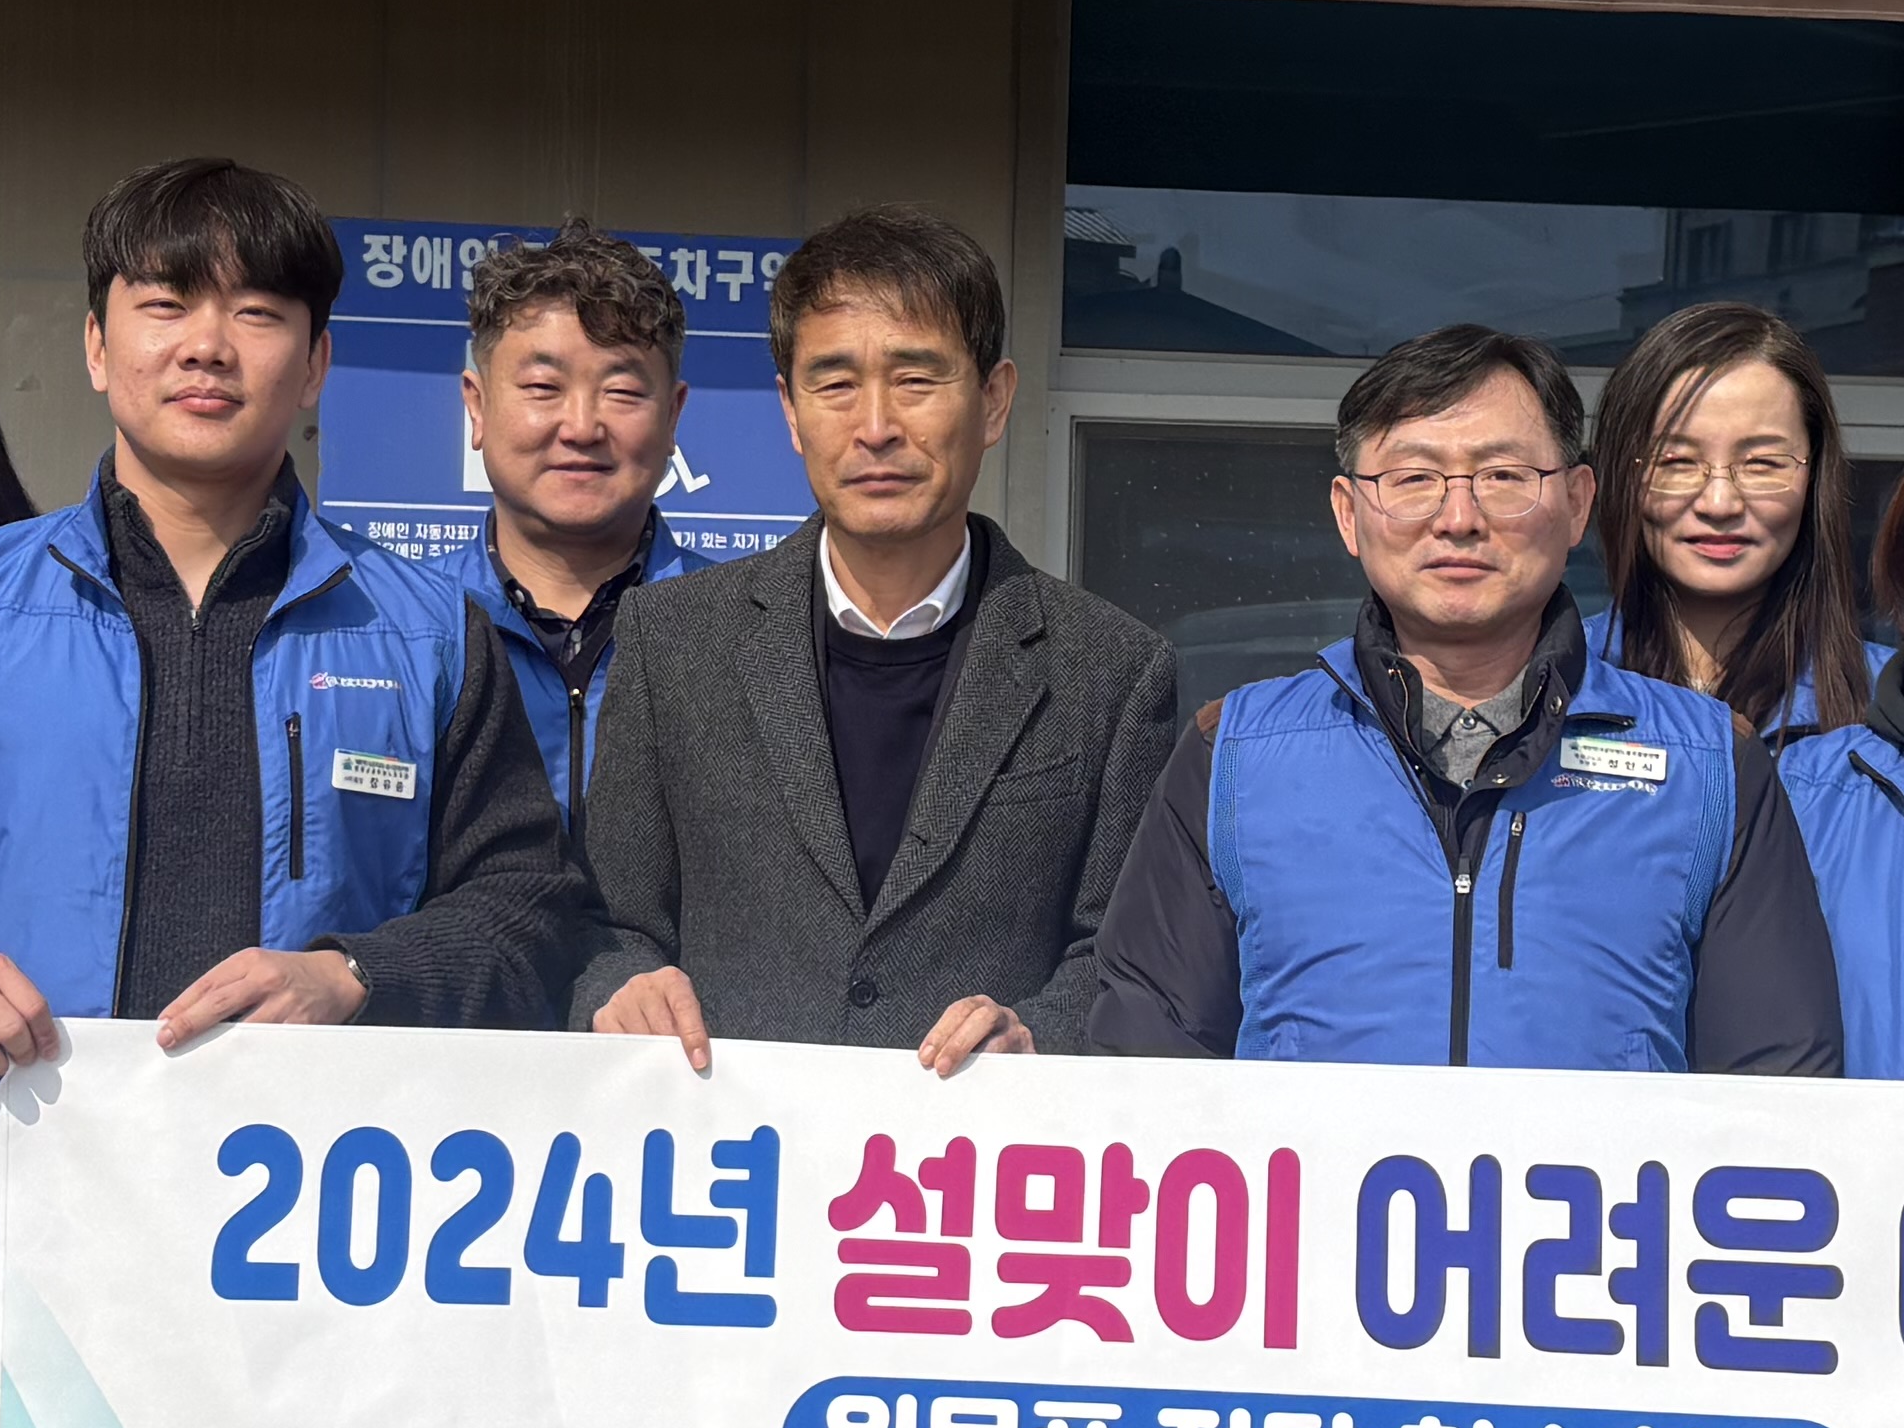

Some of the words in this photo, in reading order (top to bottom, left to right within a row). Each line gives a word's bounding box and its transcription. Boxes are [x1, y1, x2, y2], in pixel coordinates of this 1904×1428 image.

[209, 1122, 780, 1329] 2024년
[826, 1131, 1299, 1350] 설맞이
[1354, 1152, 1845, 1377] 어려운
